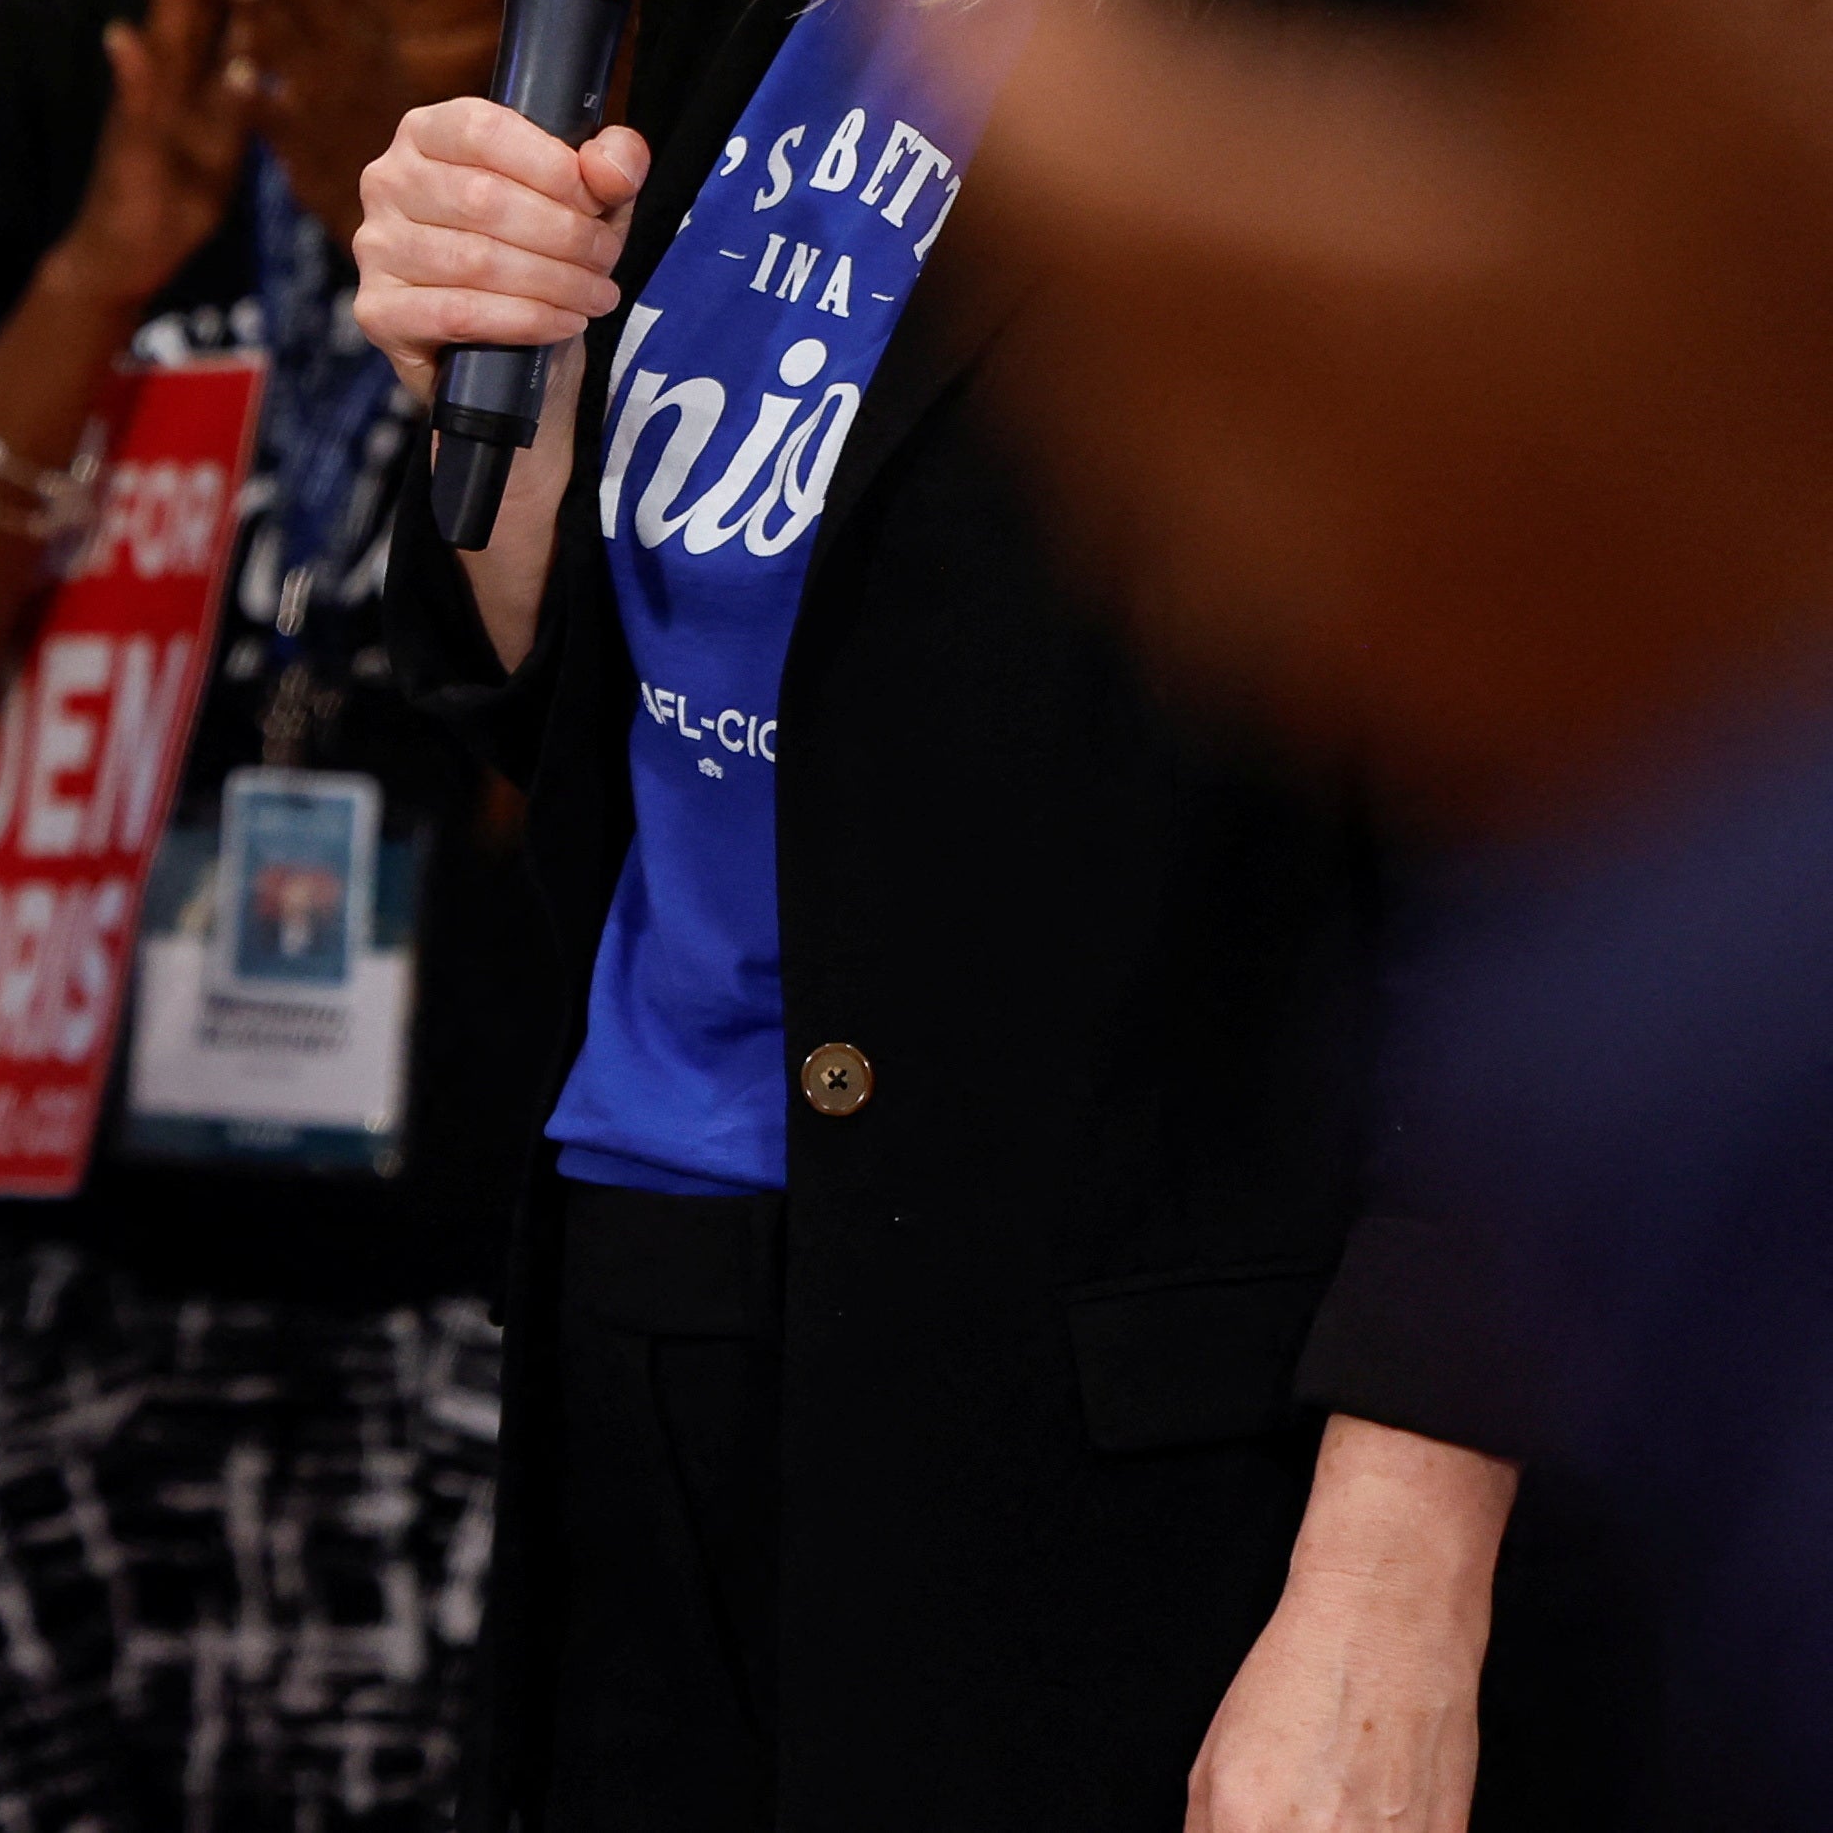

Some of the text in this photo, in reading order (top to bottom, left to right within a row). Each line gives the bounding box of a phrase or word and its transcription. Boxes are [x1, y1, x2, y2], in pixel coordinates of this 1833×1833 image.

[749, 232, 853, 319] IN A
[599, 302, 862, 557] nio
